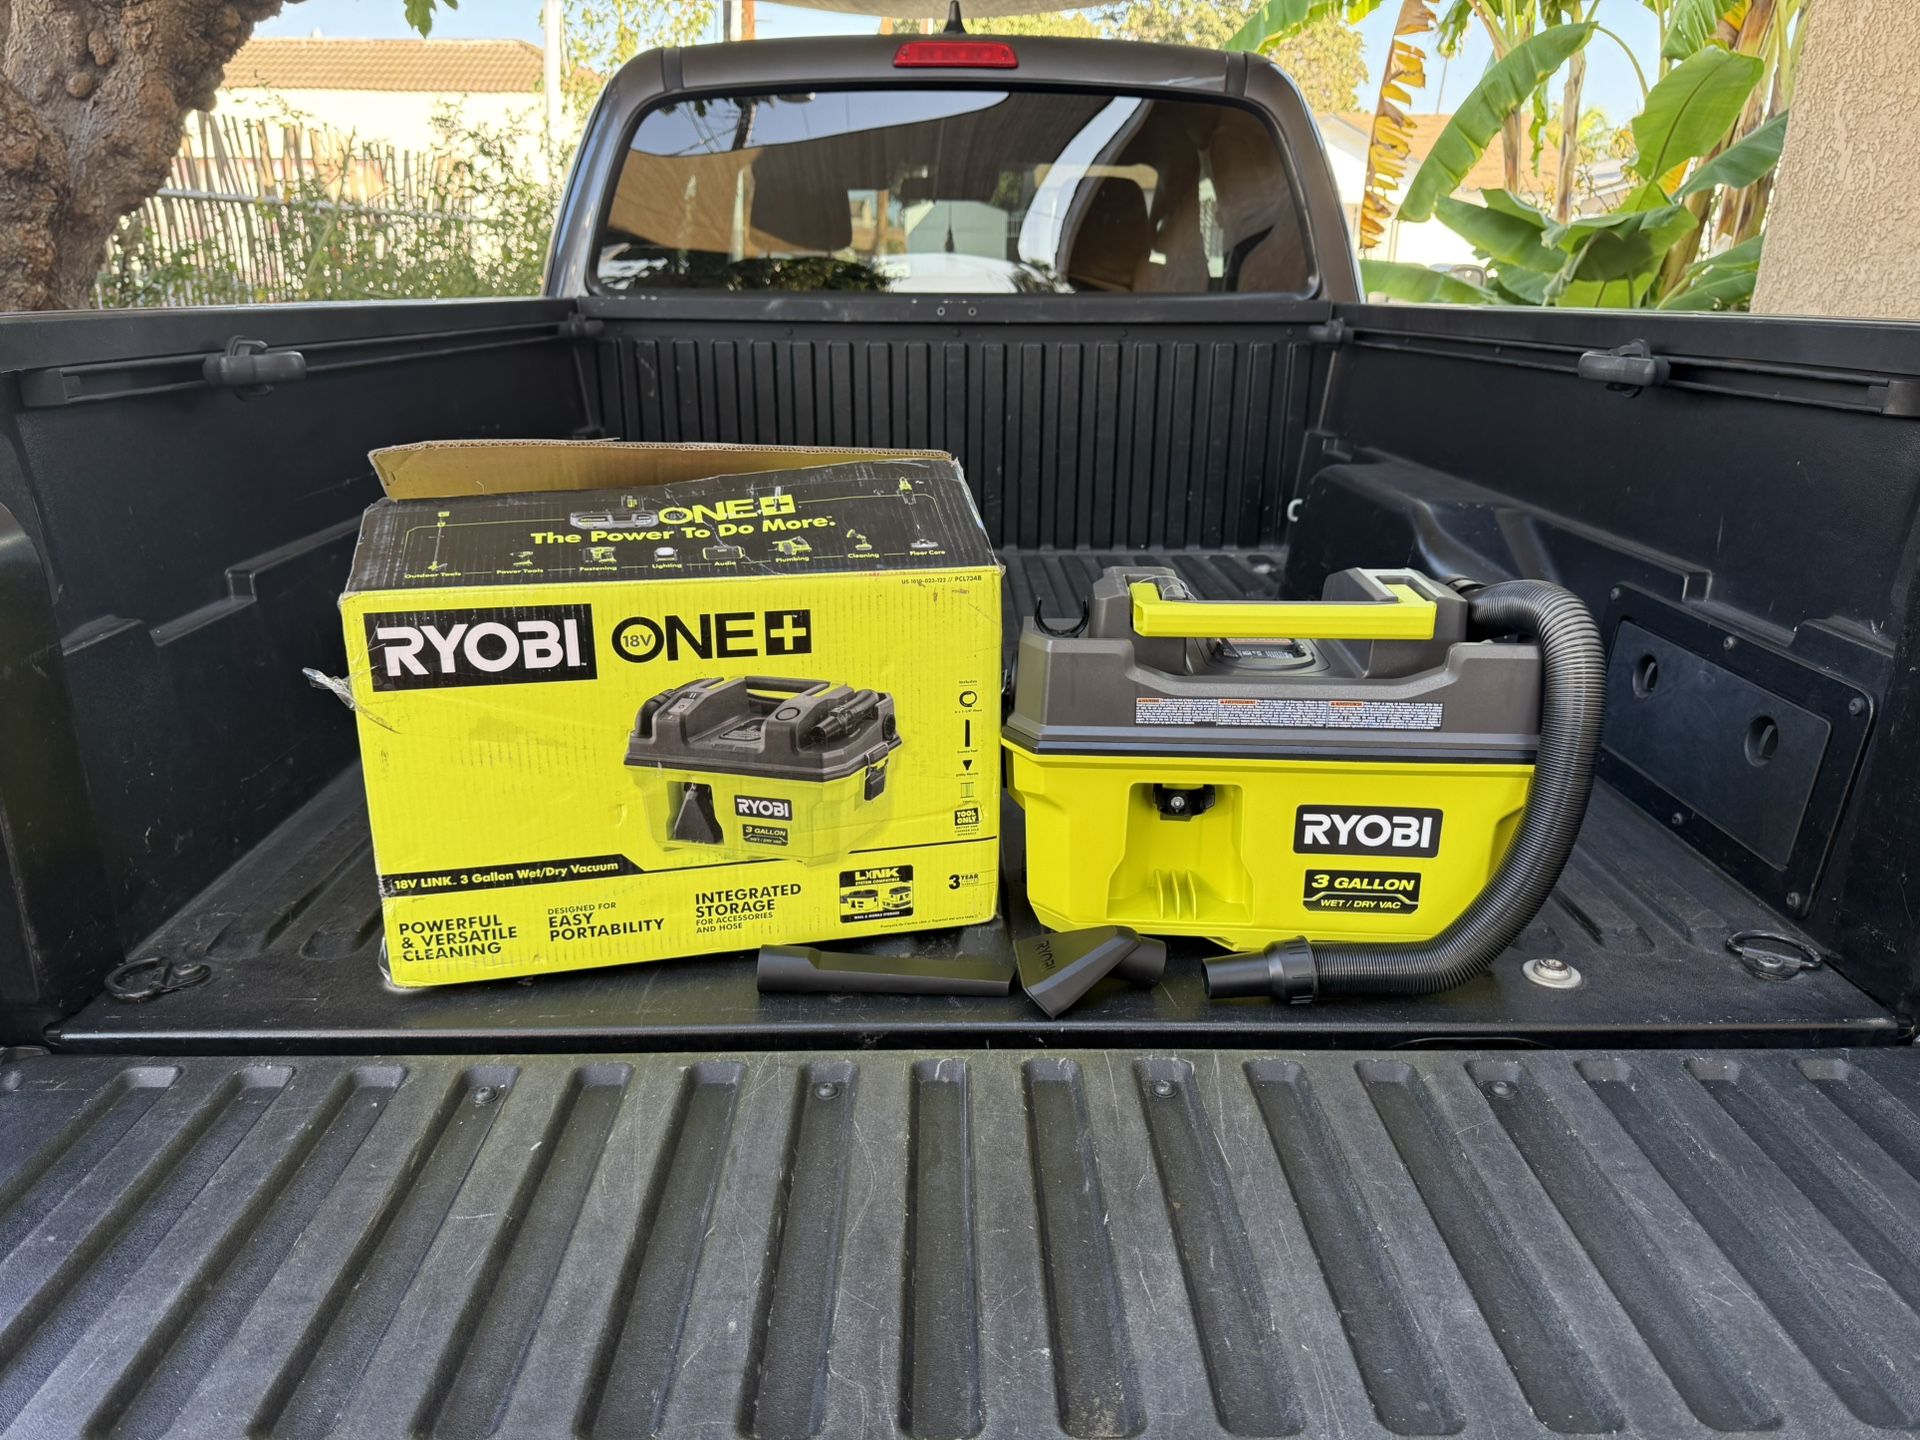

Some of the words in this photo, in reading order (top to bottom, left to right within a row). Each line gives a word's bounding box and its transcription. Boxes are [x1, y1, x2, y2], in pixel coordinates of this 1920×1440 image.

[530, 531, 581, 544] The
[590, 529, 675, 543] Power
[681, 526, 710, 540] To
[718, 524, 754, 537] Do
[775, 555, 810, 564] Plumbing
[847, 552, 880, 560] Cleaning
[579, 565, 618, 573] Fastening
[376, 619, 581, 677] RYOBI
[622, 633, 653, 648] 18V
[736, 798, 790, 818] RYOBI
[957, 810, 976, 818] TOOL
[957, 816, 977, 824] ONLY
[754, 828, 787, 837] GALLON
[1302, 813, 1433, 849] RYOBI
[394, 879, 417, 890] 18V
[460, 874, 469, 885] 3
[471, 871, 514, 884] Gallon
[517, 865, 568, 880] Wet/Dry
[570, 861, 619, 875] Vacuum
[948, 874, 961, 890] 3
[1311, 874, 1331, 888] 3
[1333, 877, 1416, 891] GALLON
[695, 883, 802, 905] INTEGRATED
[547, 904, 596, 915] DESIGNED
[598, 901, 617, 911] FOR
[695, 899, 776, 919] STORAGE
[1320, 899, 1345, 908] WET
[1345, 899, 1352, 908] /
[1353, 900, 1378, 909] DRY
[1379, 900, 1401, 910] VAC
[399, 914, 503, 936] POWERFUL
[548, 912, 594, 929] EASY
[696, 917, 714, 926] FOR
[717, 911, 774, 924] ACCESSORIES
[549, 918, 665, 942] PORTABILITY
[696, 925, 716, 934] AND
[718, 922, 743, 932] HOSE
[401, 937, 414, 949] &
[421, 926, 518, 948] VERSATILE
[402, 941, 502, 962] CLEANING
